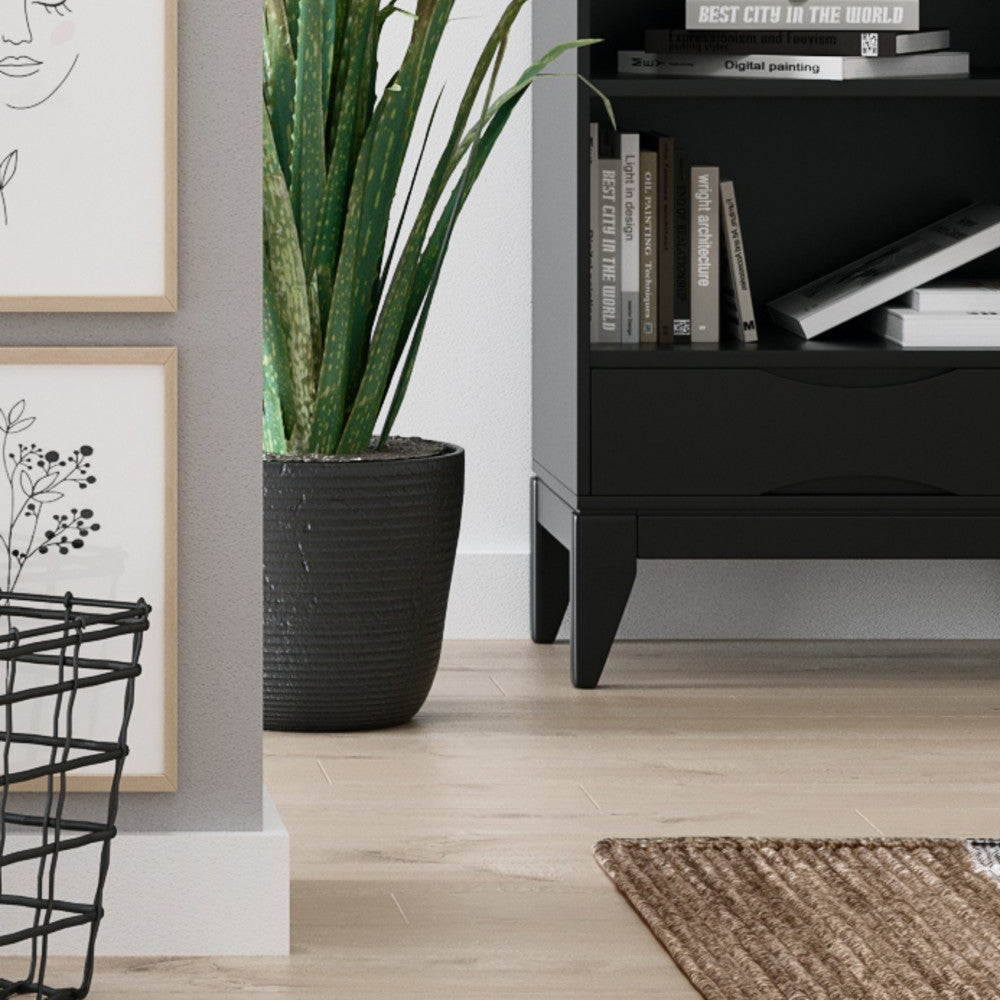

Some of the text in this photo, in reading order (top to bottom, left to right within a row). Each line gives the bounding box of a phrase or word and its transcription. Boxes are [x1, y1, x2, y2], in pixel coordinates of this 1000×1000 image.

[698, 6, 904, 24] BEST CITY IN THE WORLD
[724, 60, 820, 74] Digital painting
[602, 169, 616, 203] BEST
[623, 154, 635, 241] Light in design
[602, 204, 616, 234] CITY
[696, 174, 712, 286] wright architecture
[644, 172, 652, 318] OIL PAINTING Techniques
[602, 256, 616, 282] THE
[602, 284, 616, 332] WORLD
